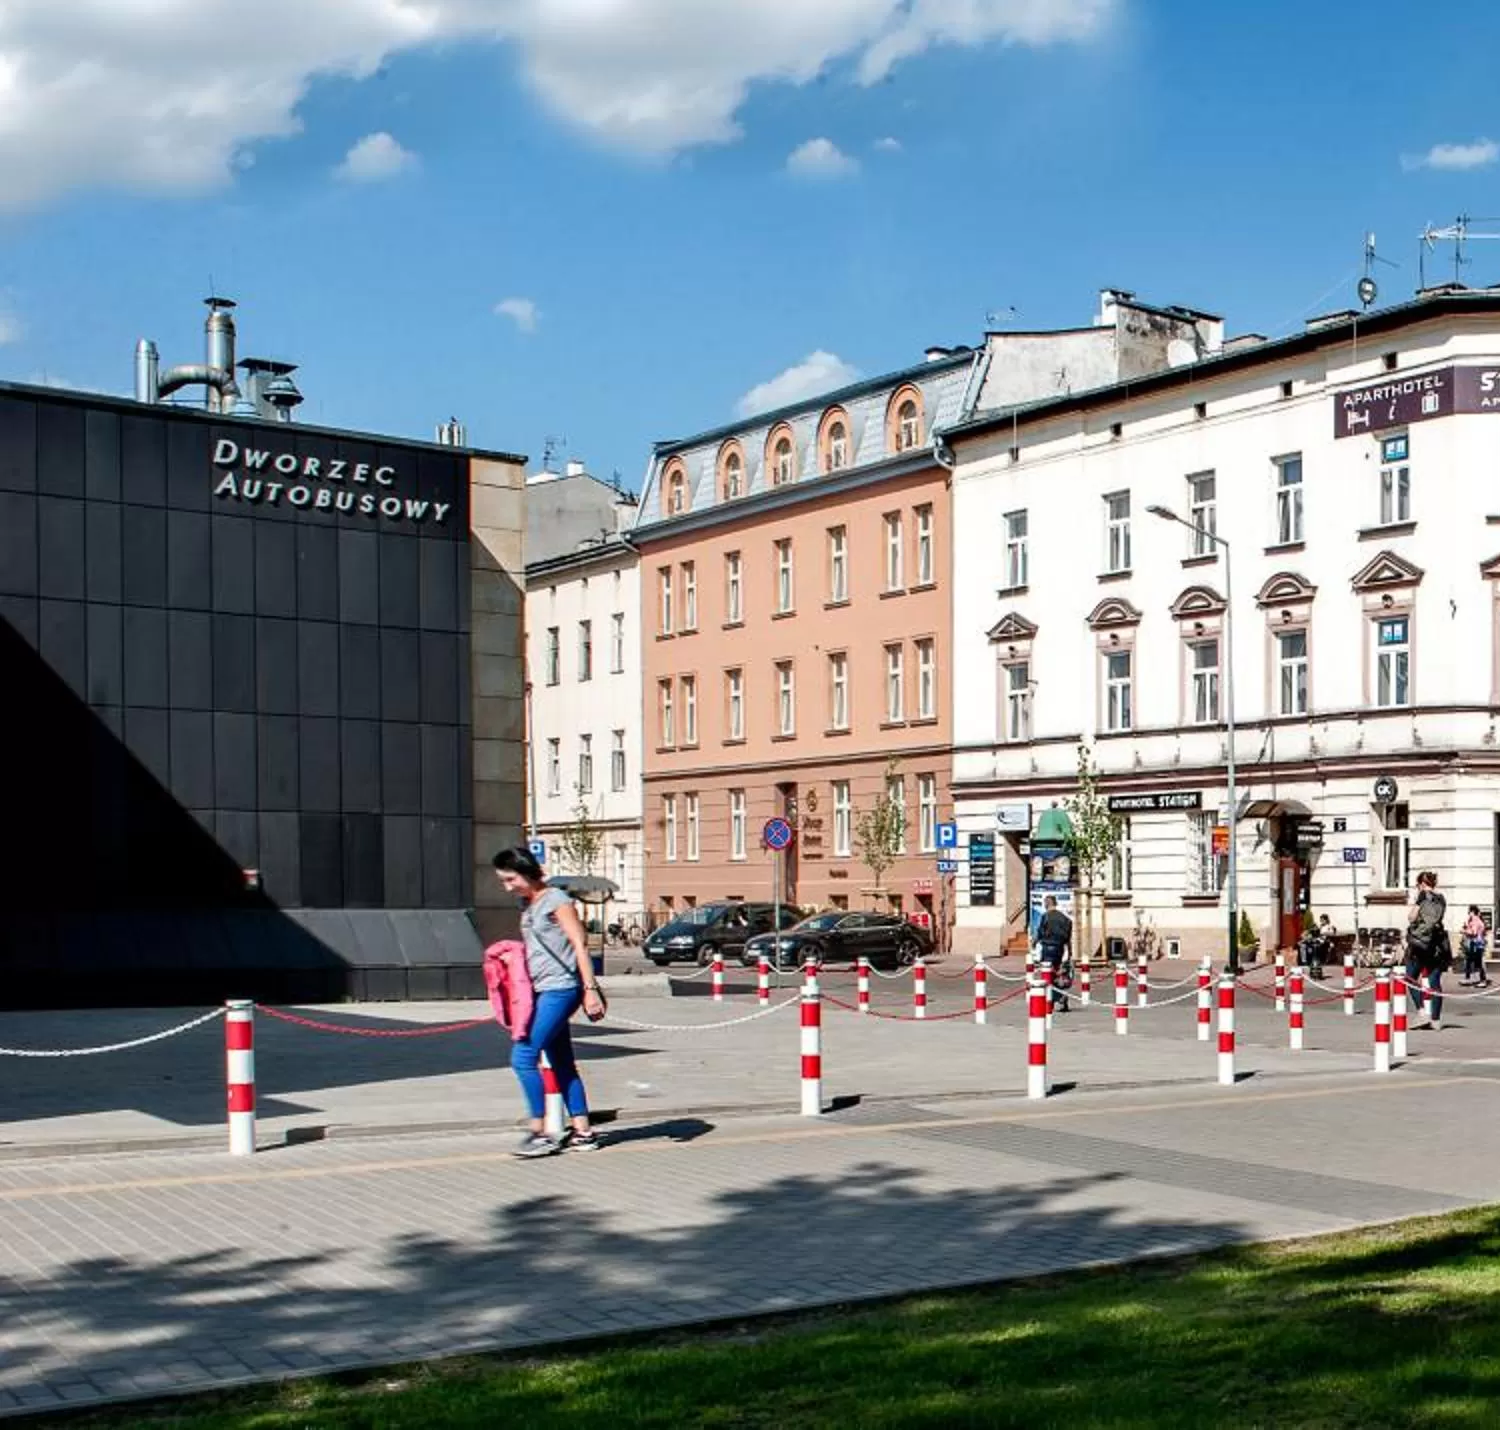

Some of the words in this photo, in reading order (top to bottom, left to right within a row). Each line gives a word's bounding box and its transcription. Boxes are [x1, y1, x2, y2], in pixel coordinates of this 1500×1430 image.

[1344, 375, 1444, 408] APARTHOTEL
[213, 439, 394, 485] DWORZEC
[214, 472, 449, 521] AUTOBUSOWY
[940, 826, 953, 845] P
